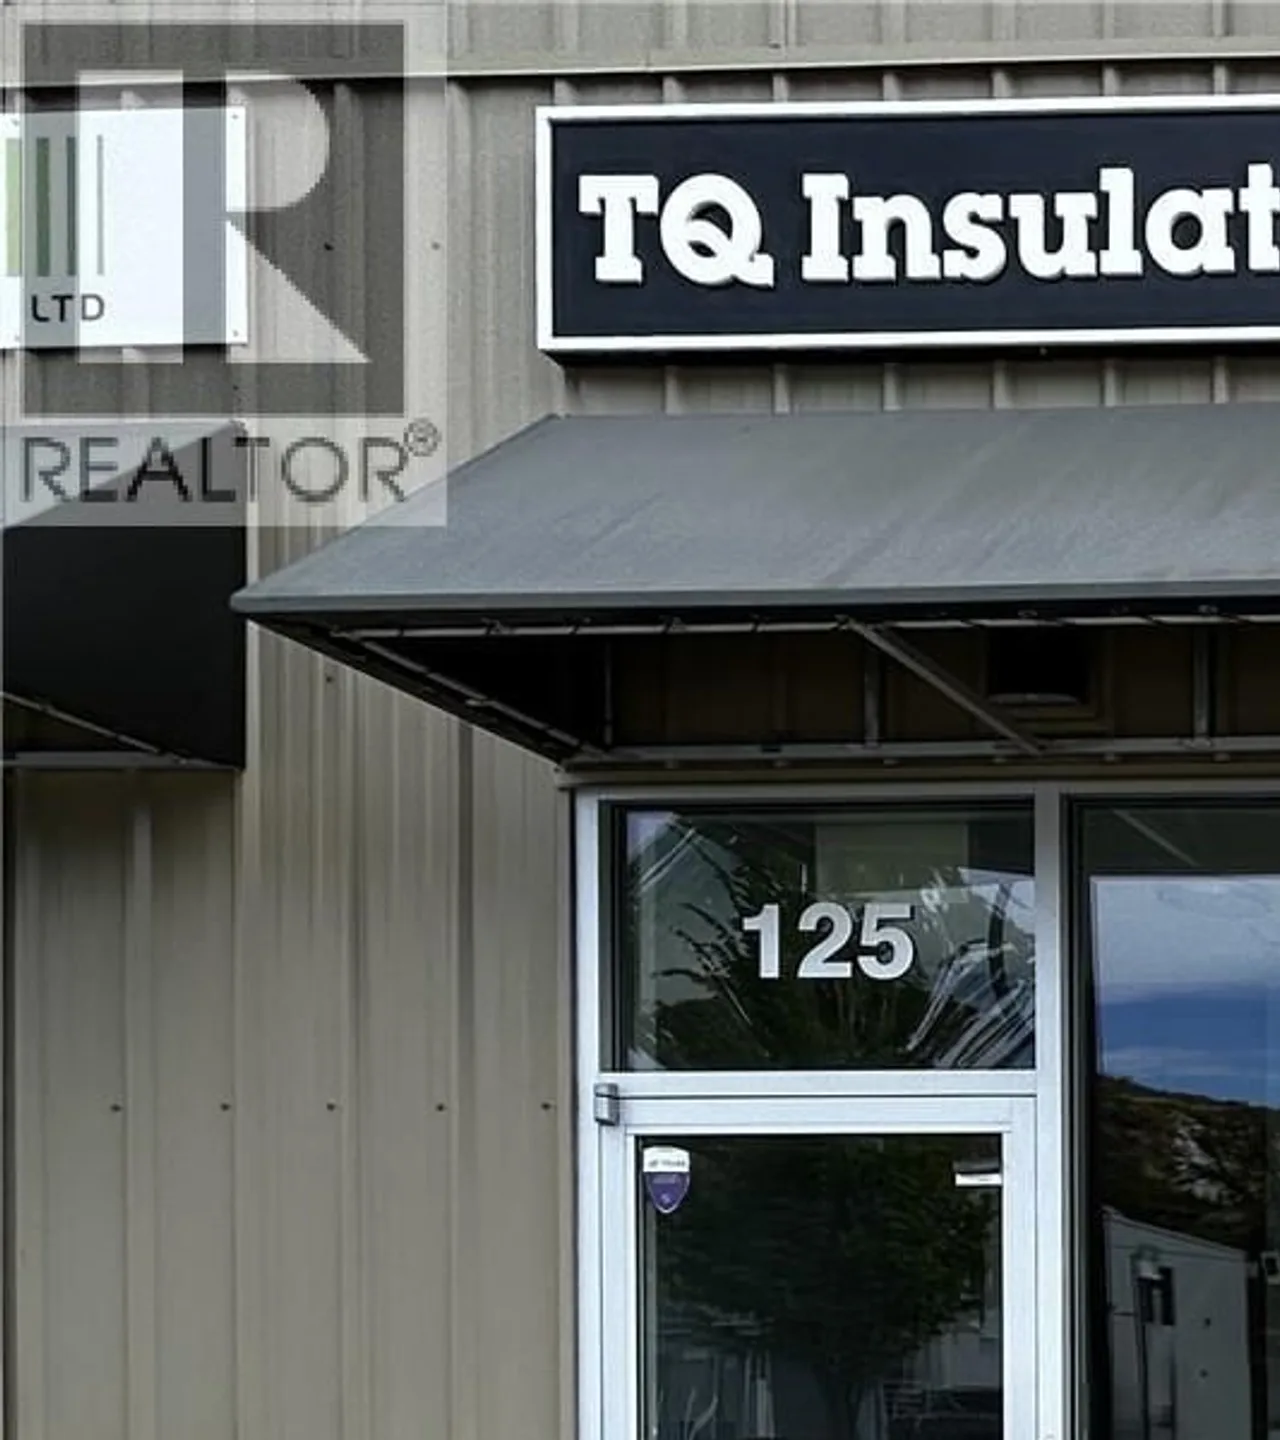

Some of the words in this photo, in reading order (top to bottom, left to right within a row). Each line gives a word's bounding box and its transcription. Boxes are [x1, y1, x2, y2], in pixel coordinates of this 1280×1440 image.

[578, 172, 775, 288] TQ
[31, 292, 105, 323] LTD
[741, 902, 916, 980] 125
